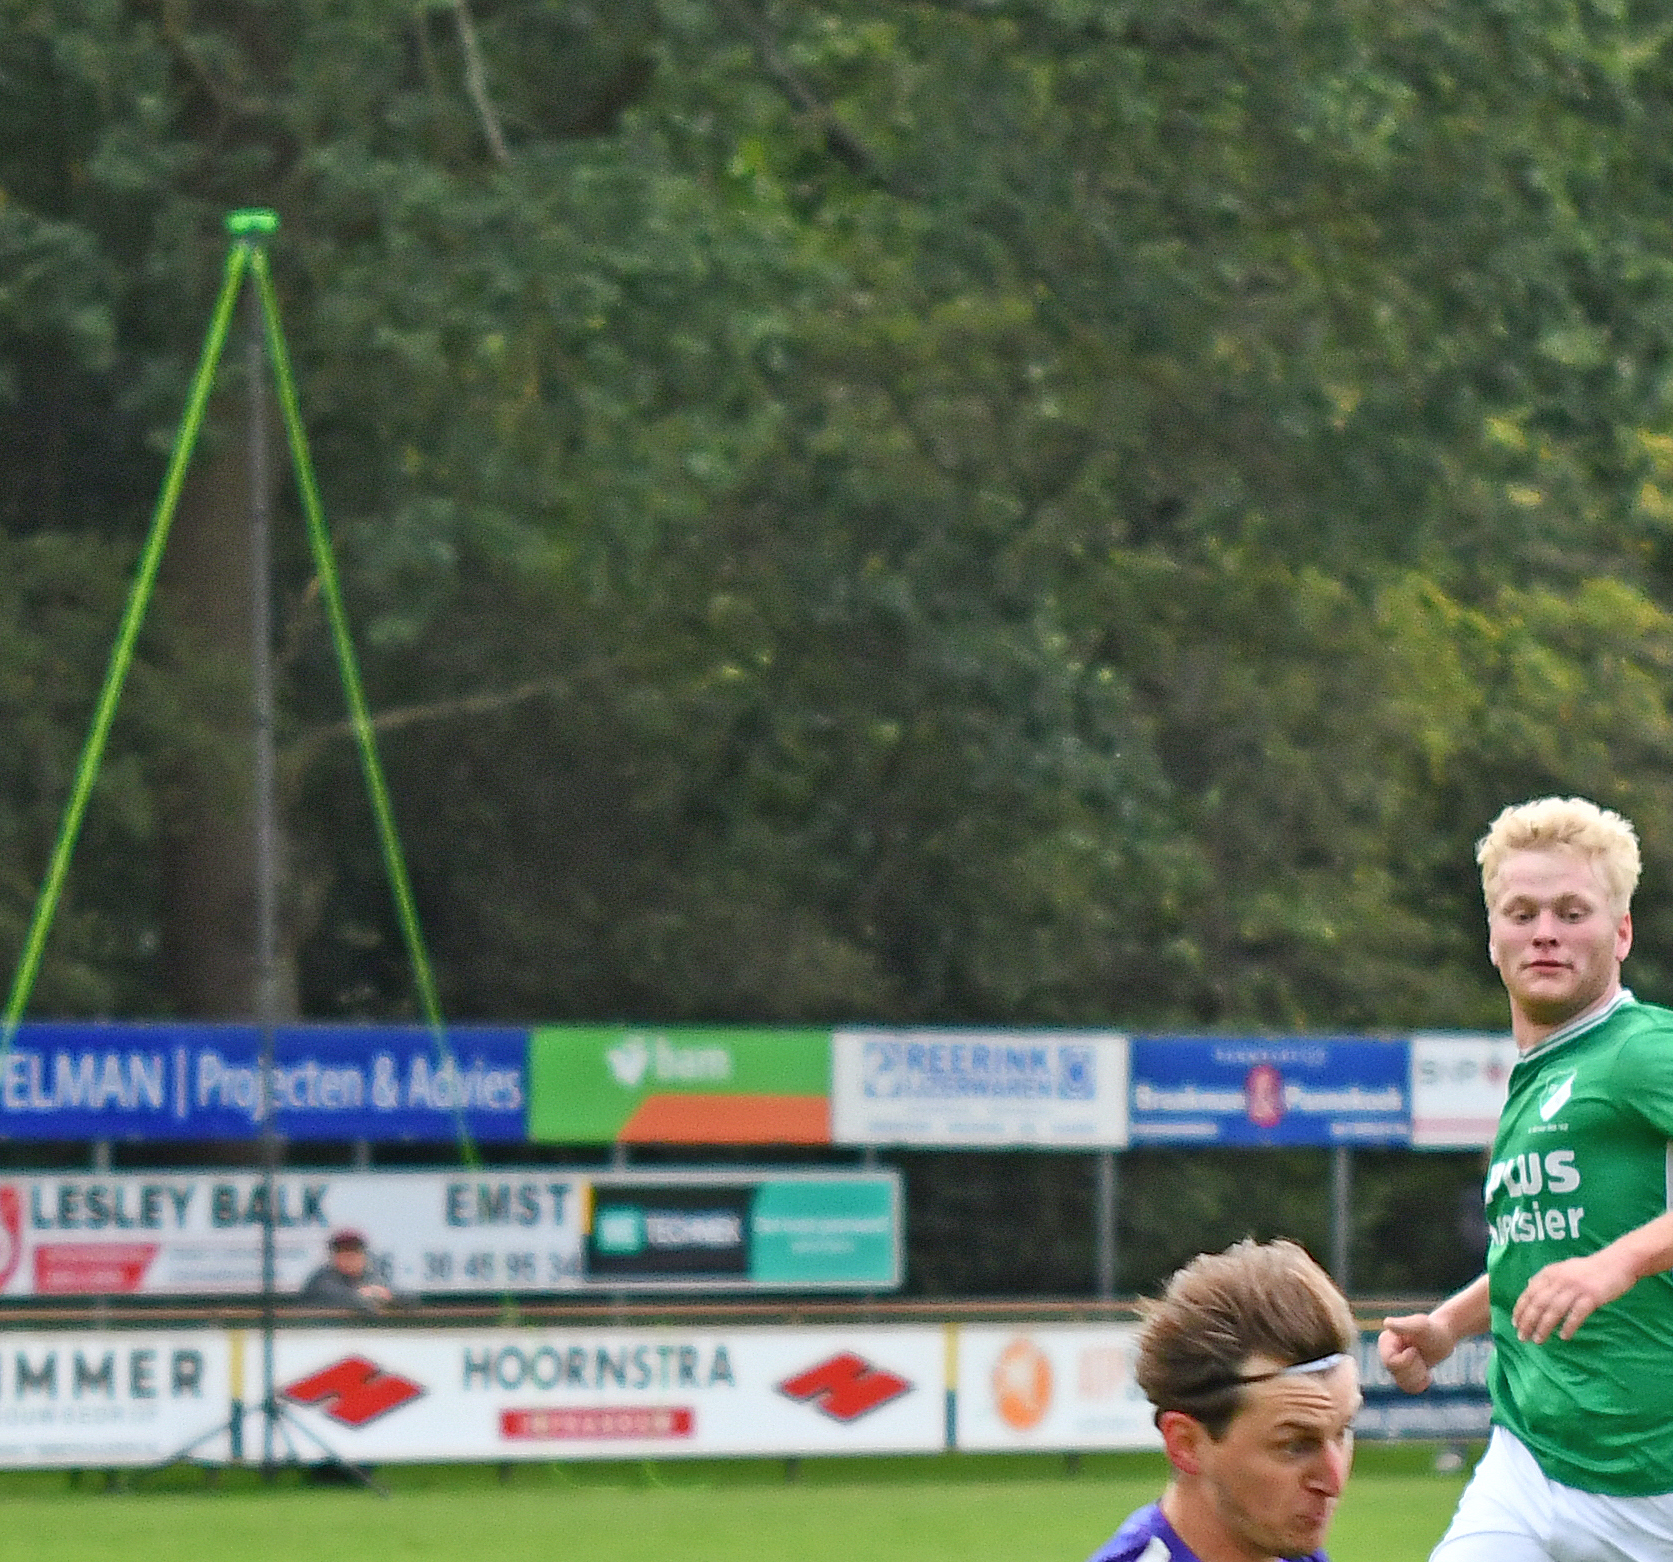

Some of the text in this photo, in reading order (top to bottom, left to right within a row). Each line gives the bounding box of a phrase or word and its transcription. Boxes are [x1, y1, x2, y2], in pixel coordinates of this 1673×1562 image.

[198, 1052, 364, 1122] Projecten
[372, 1053, 399, 1110] &
[408, 1054, 523, 1112] Advies
[29, 1182, 573, 1230] LESLEY BALK EMST
[1489, 1200, 1585, 1245] tsier
[462, 1345, 736, 1392] HOORNSTRA
